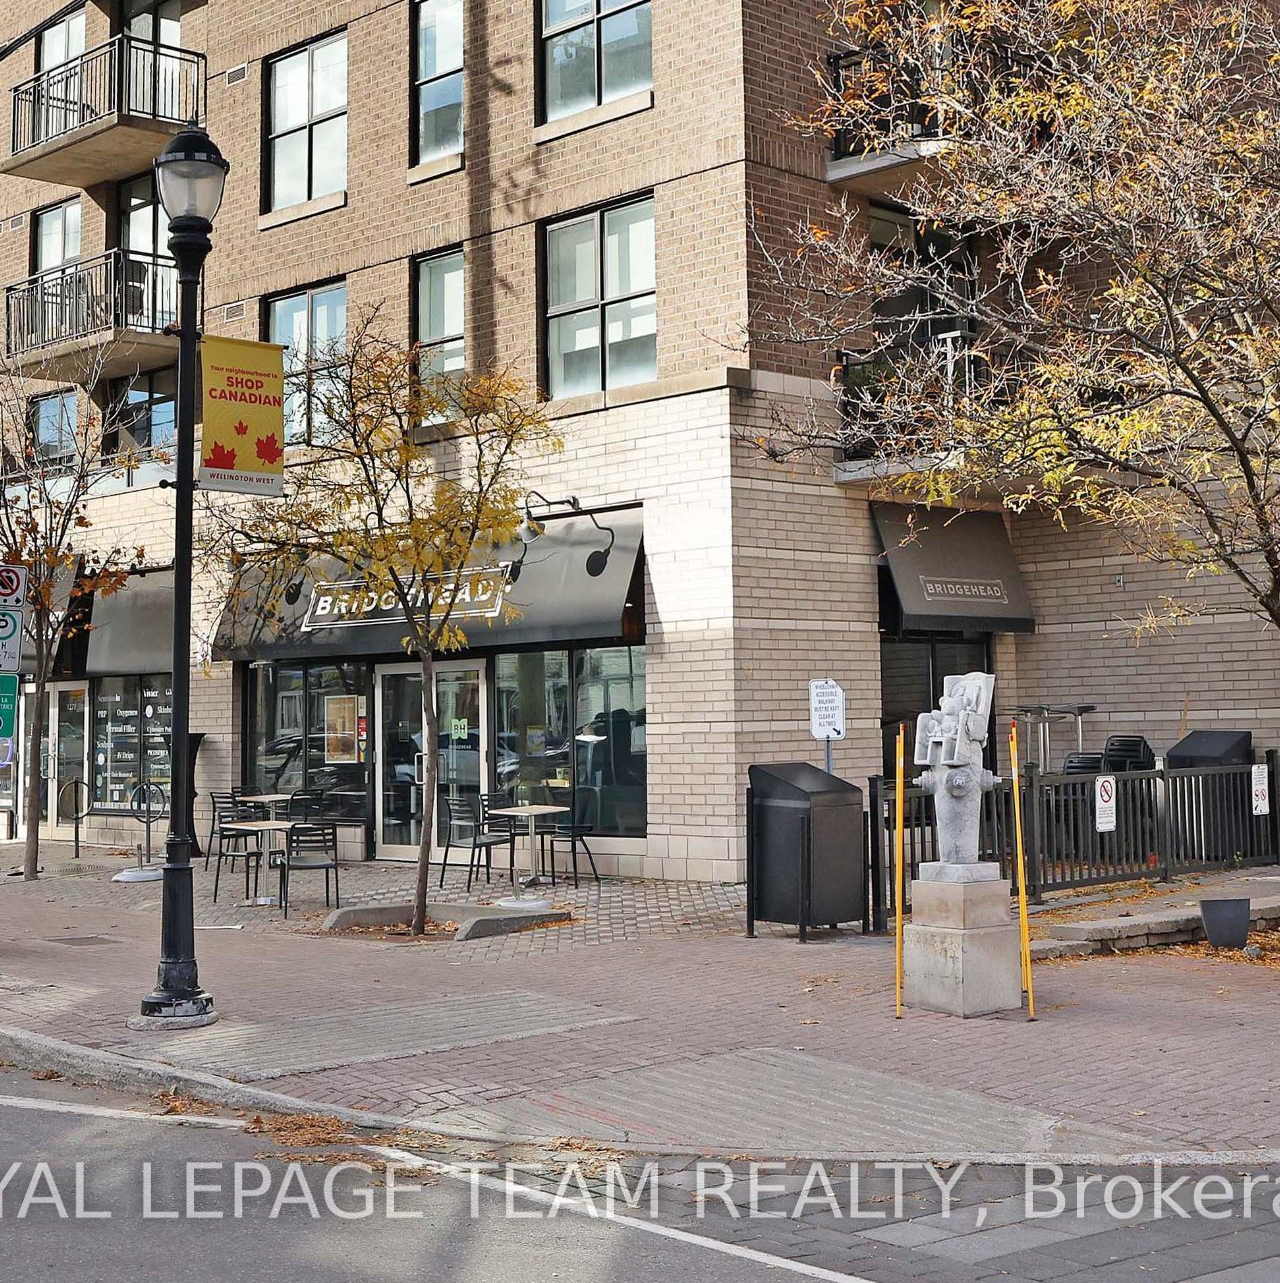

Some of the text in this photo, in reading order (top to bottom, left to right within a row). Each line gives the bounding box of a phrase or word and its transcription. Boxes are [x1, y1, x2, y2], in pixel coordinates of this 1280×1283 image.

[225, 366, 270, 378] neighbourhood
[226, 377, 264, 390] SHOP
[208, 388, 282, 407] CANADIAN
[209, 473, 275, 484] WELLINGTON WEST
[926, 583, 1001, 596] BRIDGEHEAD
[1, 641, 7, 650] H
[454, 725, 465, 733] BH
